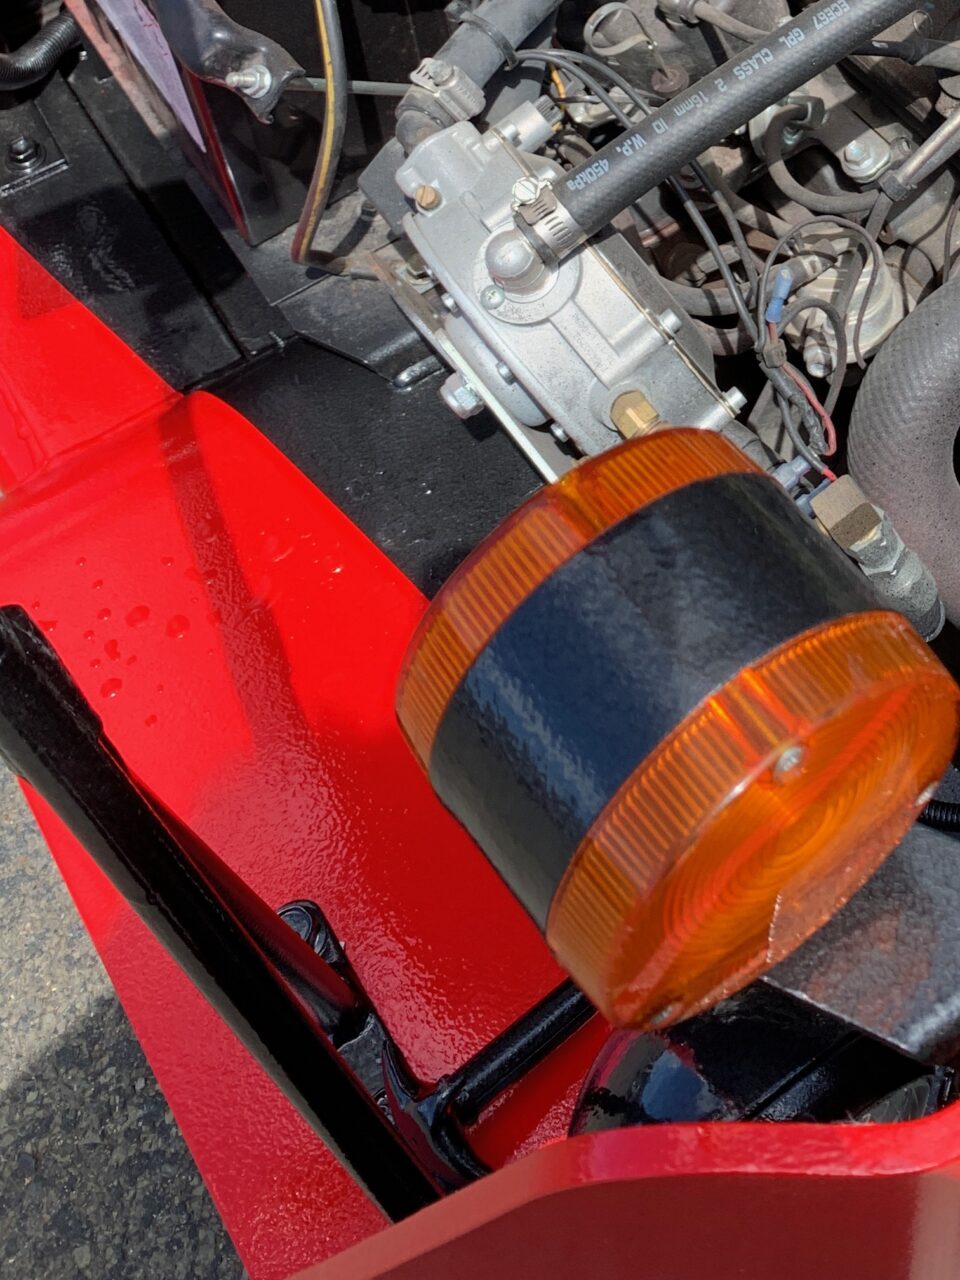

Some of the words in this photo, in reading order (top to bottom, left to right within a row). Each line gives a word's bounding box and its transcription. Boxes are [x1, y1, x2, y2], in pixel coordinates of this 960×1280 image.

[776, 24, 808, 54] GPL
[730, 44, 776, 83] CLASS
[670, 87, 710, 122] 16mm
[649, 115, 670, 137] ID
[563, 154, 613, 197] 450kPa
